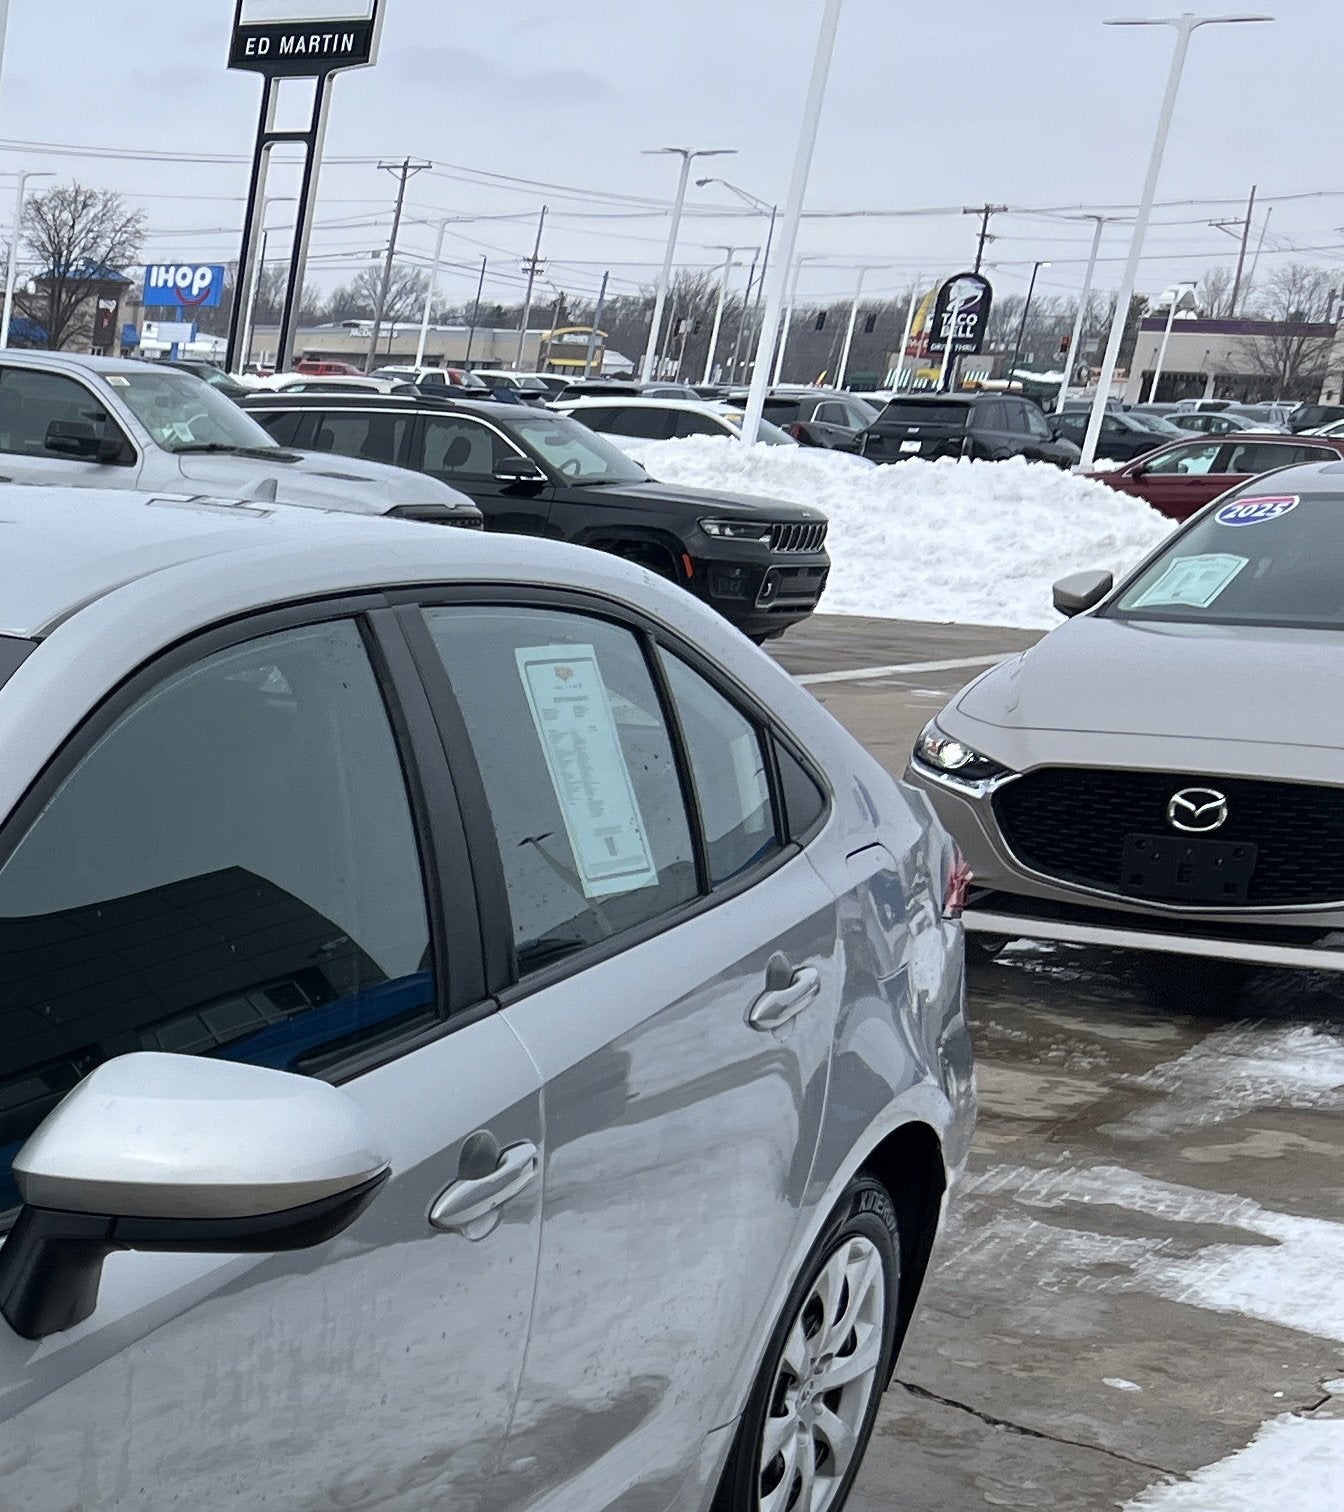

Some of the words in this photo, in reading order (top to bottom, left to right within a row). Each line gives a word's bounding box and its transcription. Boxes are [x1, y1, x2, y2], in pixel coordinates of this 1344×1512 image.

[245, 37, 270, 56] ED
[279, 33, 355, 55] MARTIN
[1220, 503, 1290, 519] 2025
